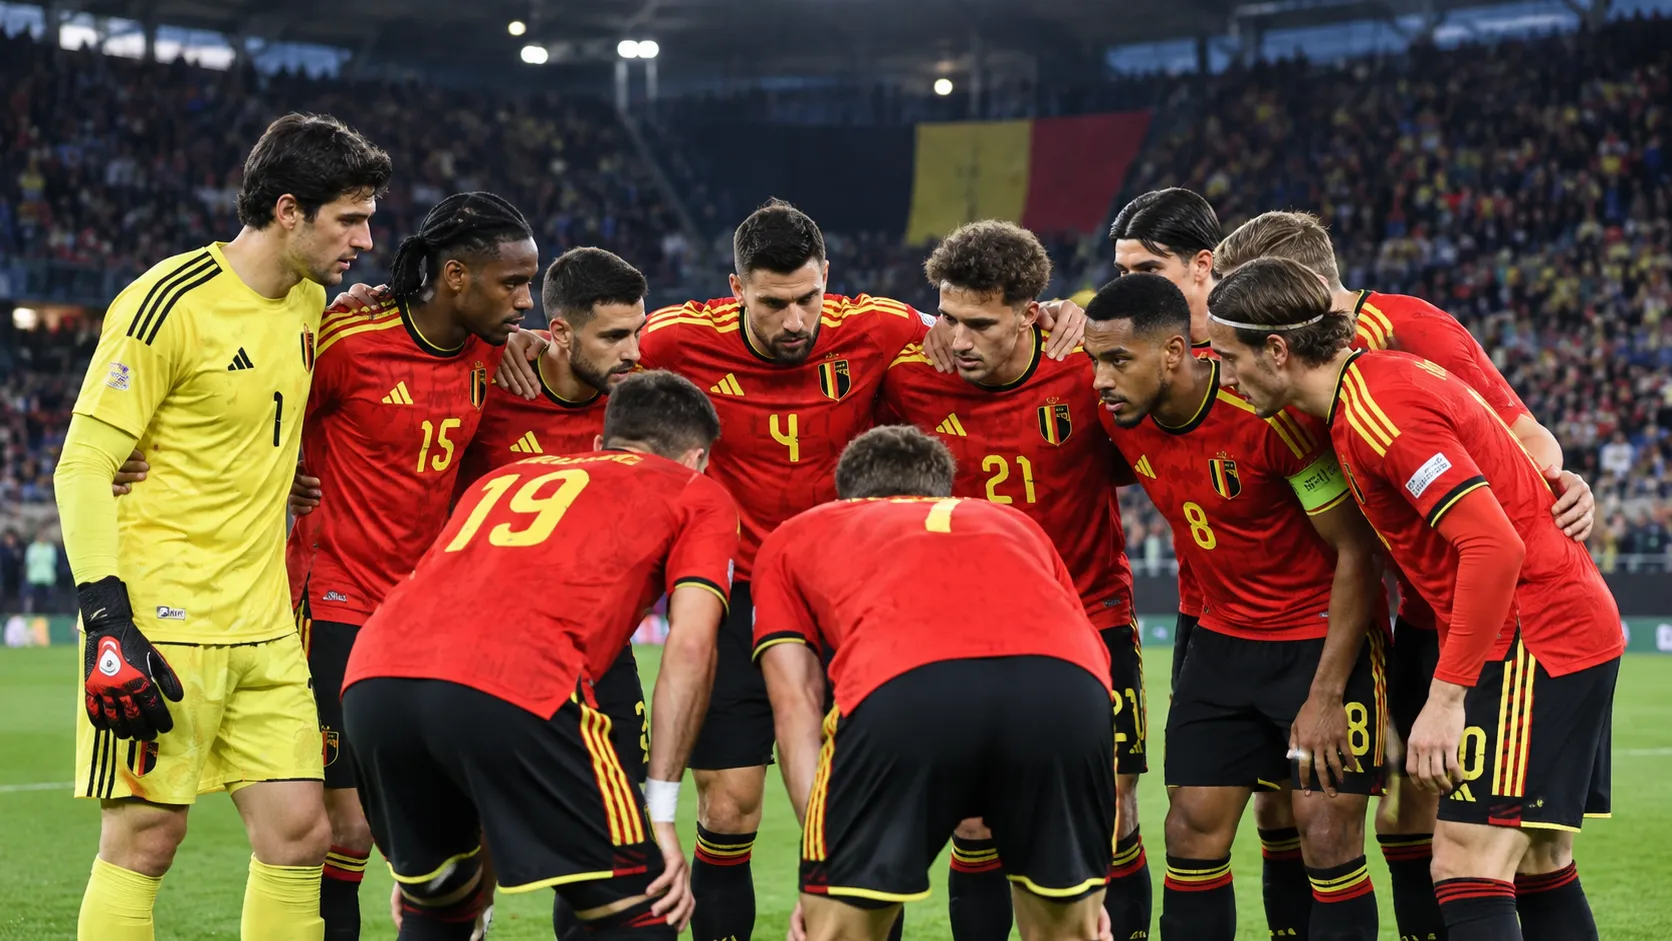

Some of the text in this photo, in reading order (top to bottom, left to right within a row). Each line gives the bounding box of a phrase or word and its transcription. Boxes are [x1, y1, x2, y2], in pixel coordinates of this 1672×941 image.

[273, 391, 284, 447] 1
[416, 418, 461, 473] 15
[769, 413, 800, 462] 4
[982, 454, 1036, 504] 21
[444, 468, 590, 552] 19
[1183, 501, 1217, 550] 8
[1344, 701, 1370, 756] 8
[1447, 725, 1487, 781] 0
